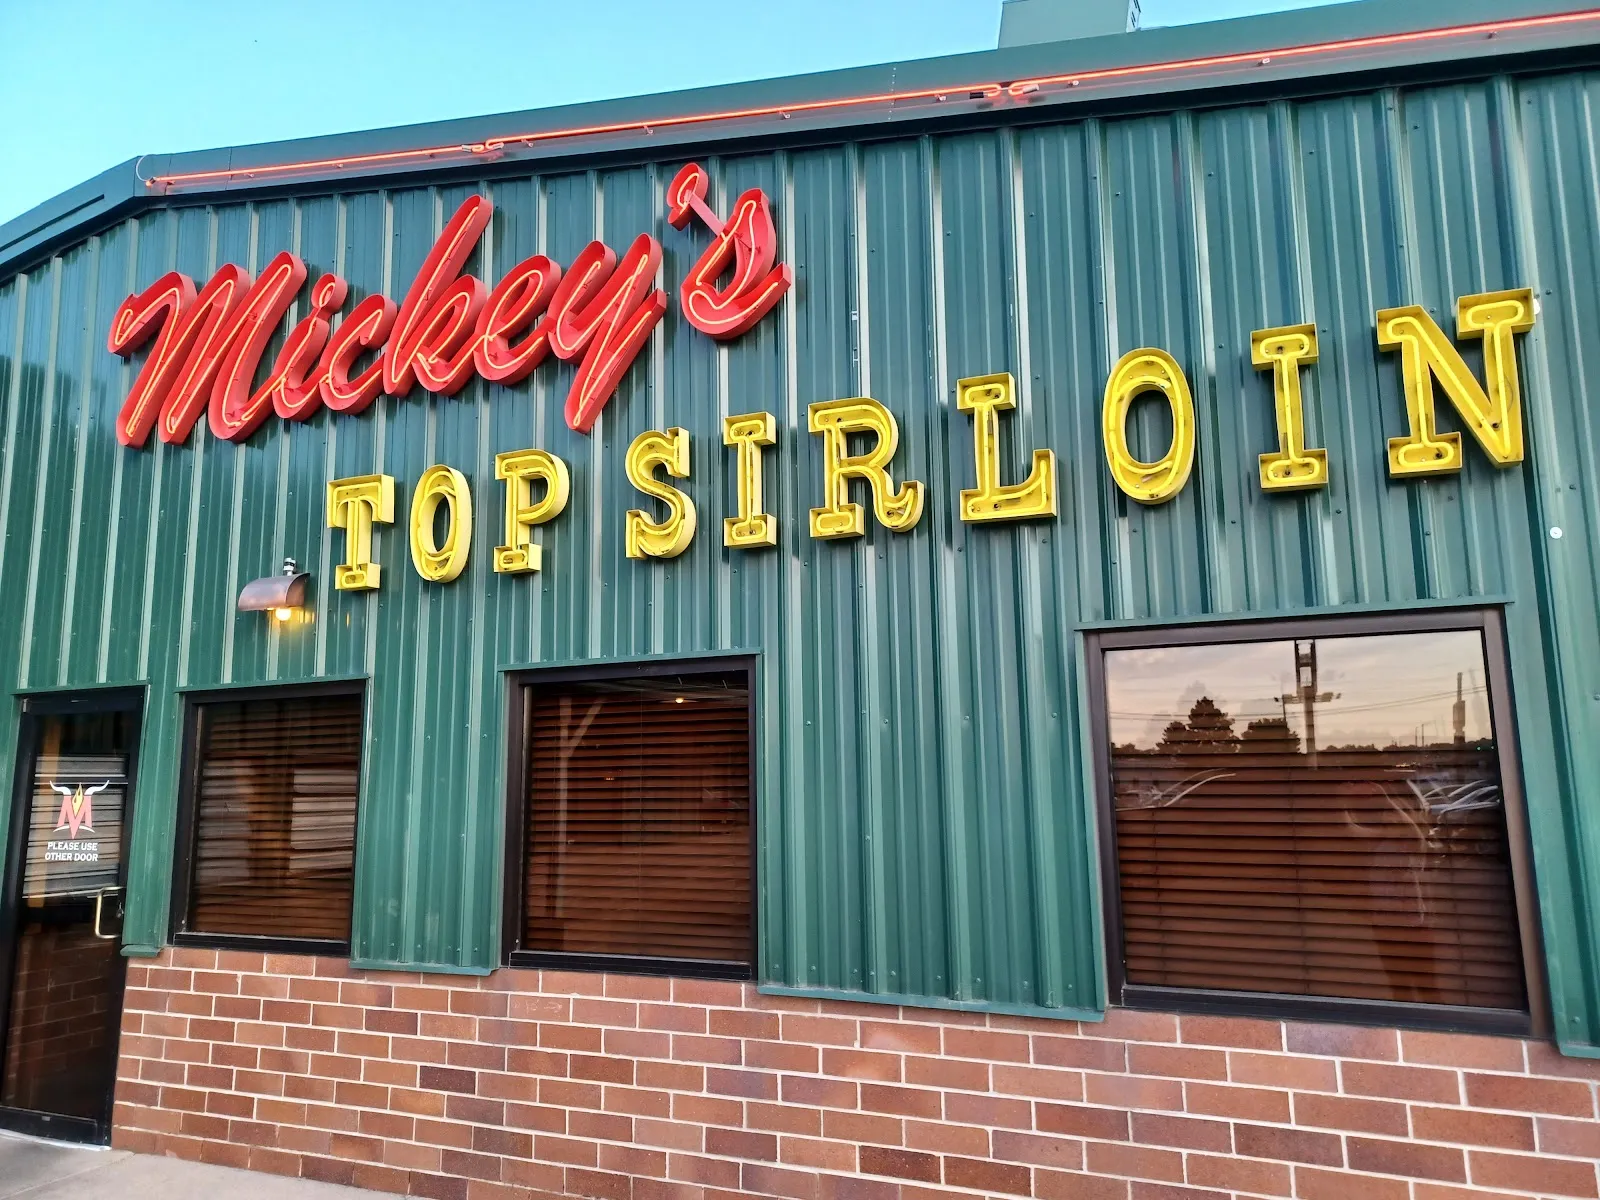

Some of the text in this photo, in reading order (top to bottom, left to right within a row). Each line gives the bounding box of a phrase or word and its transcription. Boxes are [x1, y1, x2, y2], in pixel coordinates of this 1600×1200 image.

[107, 162, 791, 447] Mickey's
[327, 287, 1534, 592] TOP SIRLOIN
[45, 852, 98, 862] OTHER DOOR
[47, 841, 98, 851] PLEASE USE
